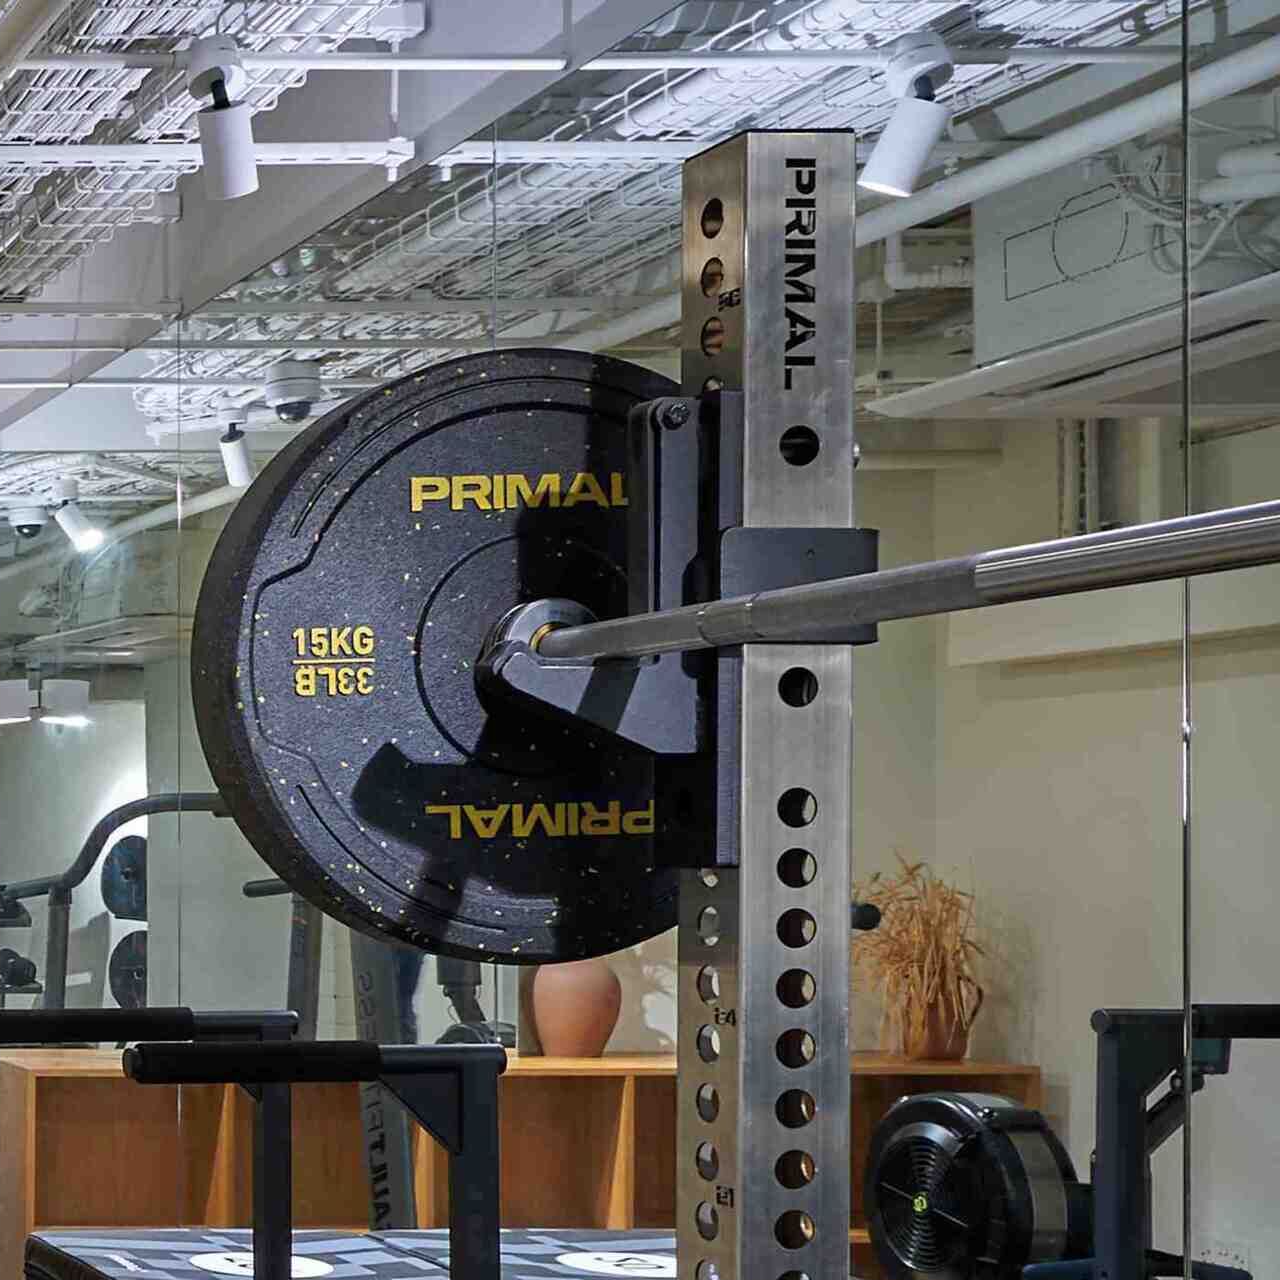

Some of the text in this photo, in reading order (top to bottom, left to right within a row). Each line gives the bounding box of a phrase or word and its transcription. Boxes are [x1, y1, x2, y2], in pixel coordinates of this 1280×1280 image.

[784, 157, 816, 390] PRIMAL
[410, 472, 628, 512] PRIMAL
[292, 626, 374, 657] 15KG
[295, 665, 374, 696] 33LB
[425, 799, 655, 840] PRIMAL
